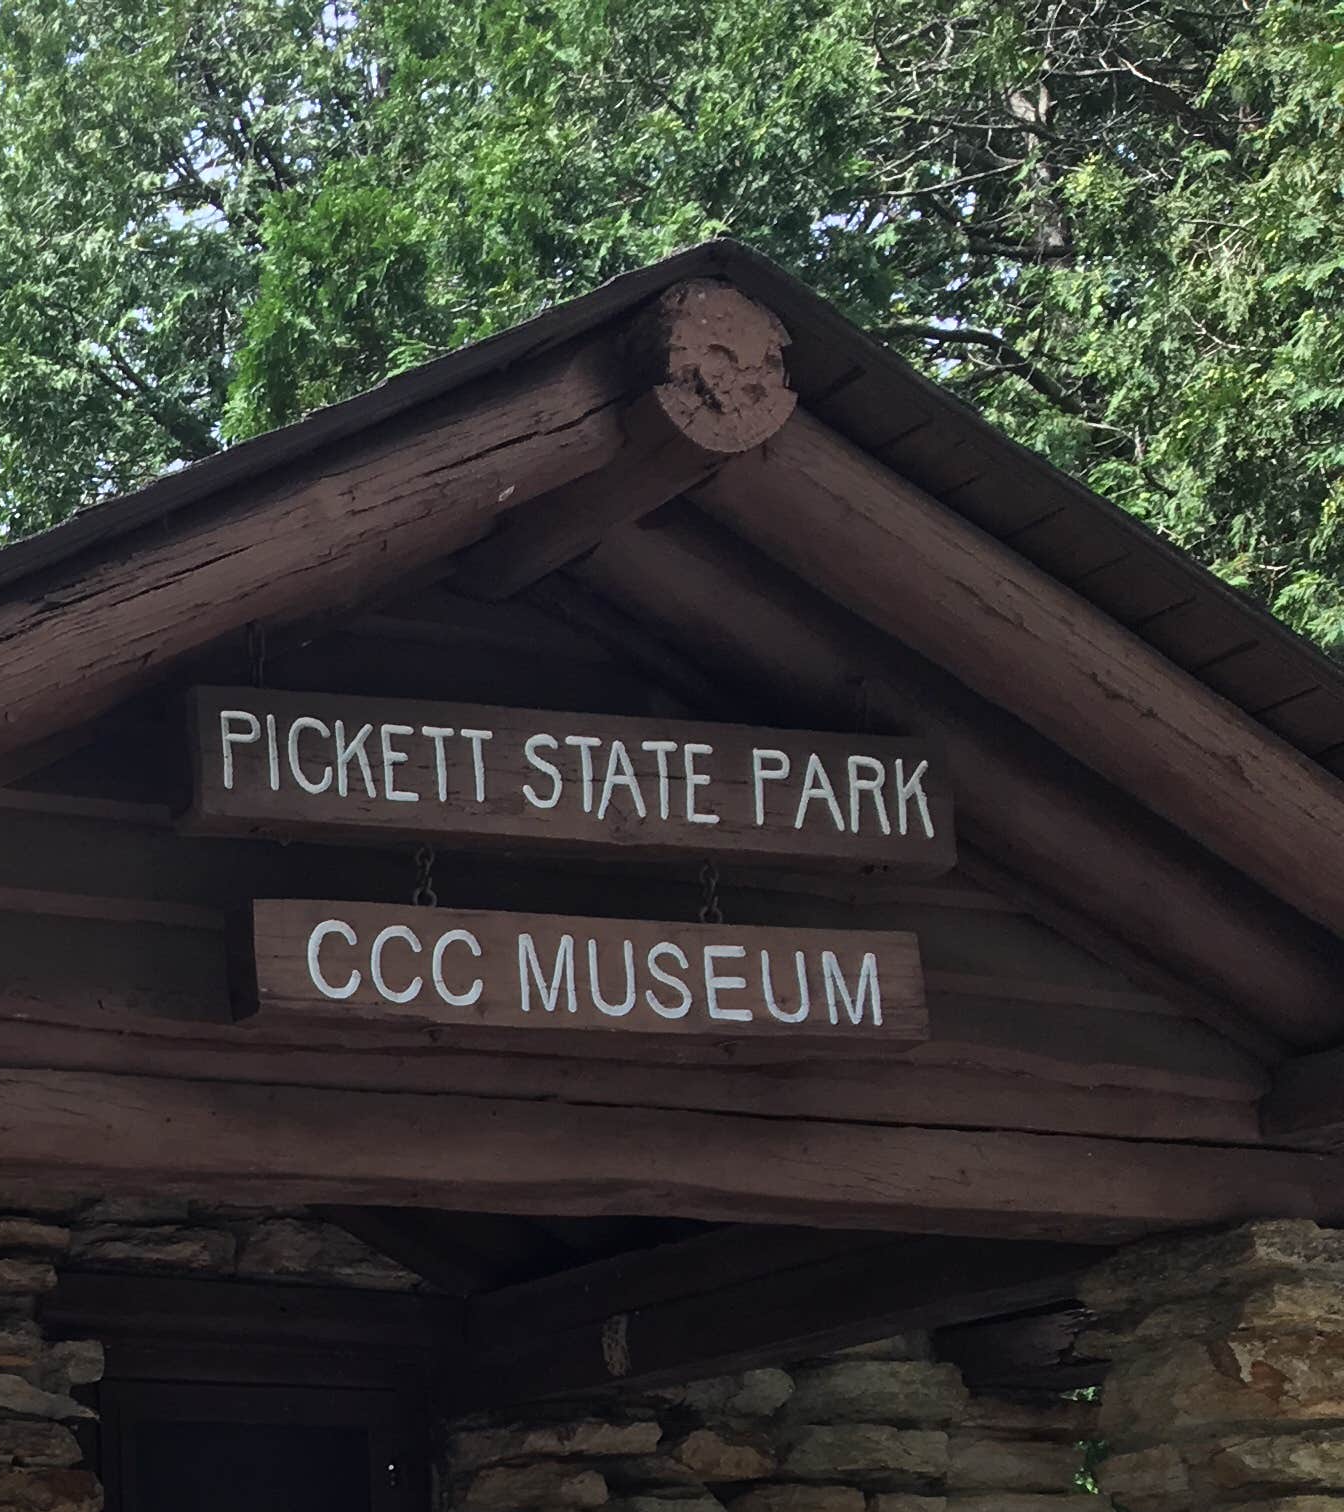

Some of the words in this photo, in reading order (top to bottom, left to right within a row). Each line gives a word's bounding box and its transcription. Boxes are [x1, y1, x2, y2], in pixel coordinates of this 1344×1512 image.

[219, 709, 494, 803] PICKETT
[521, 732, 721, 825] STATE
[751, 746, 935, 839] PARK
[306, 918, 485, 1008] CCC
[517, 932, 884, 1027] MUSEUM
